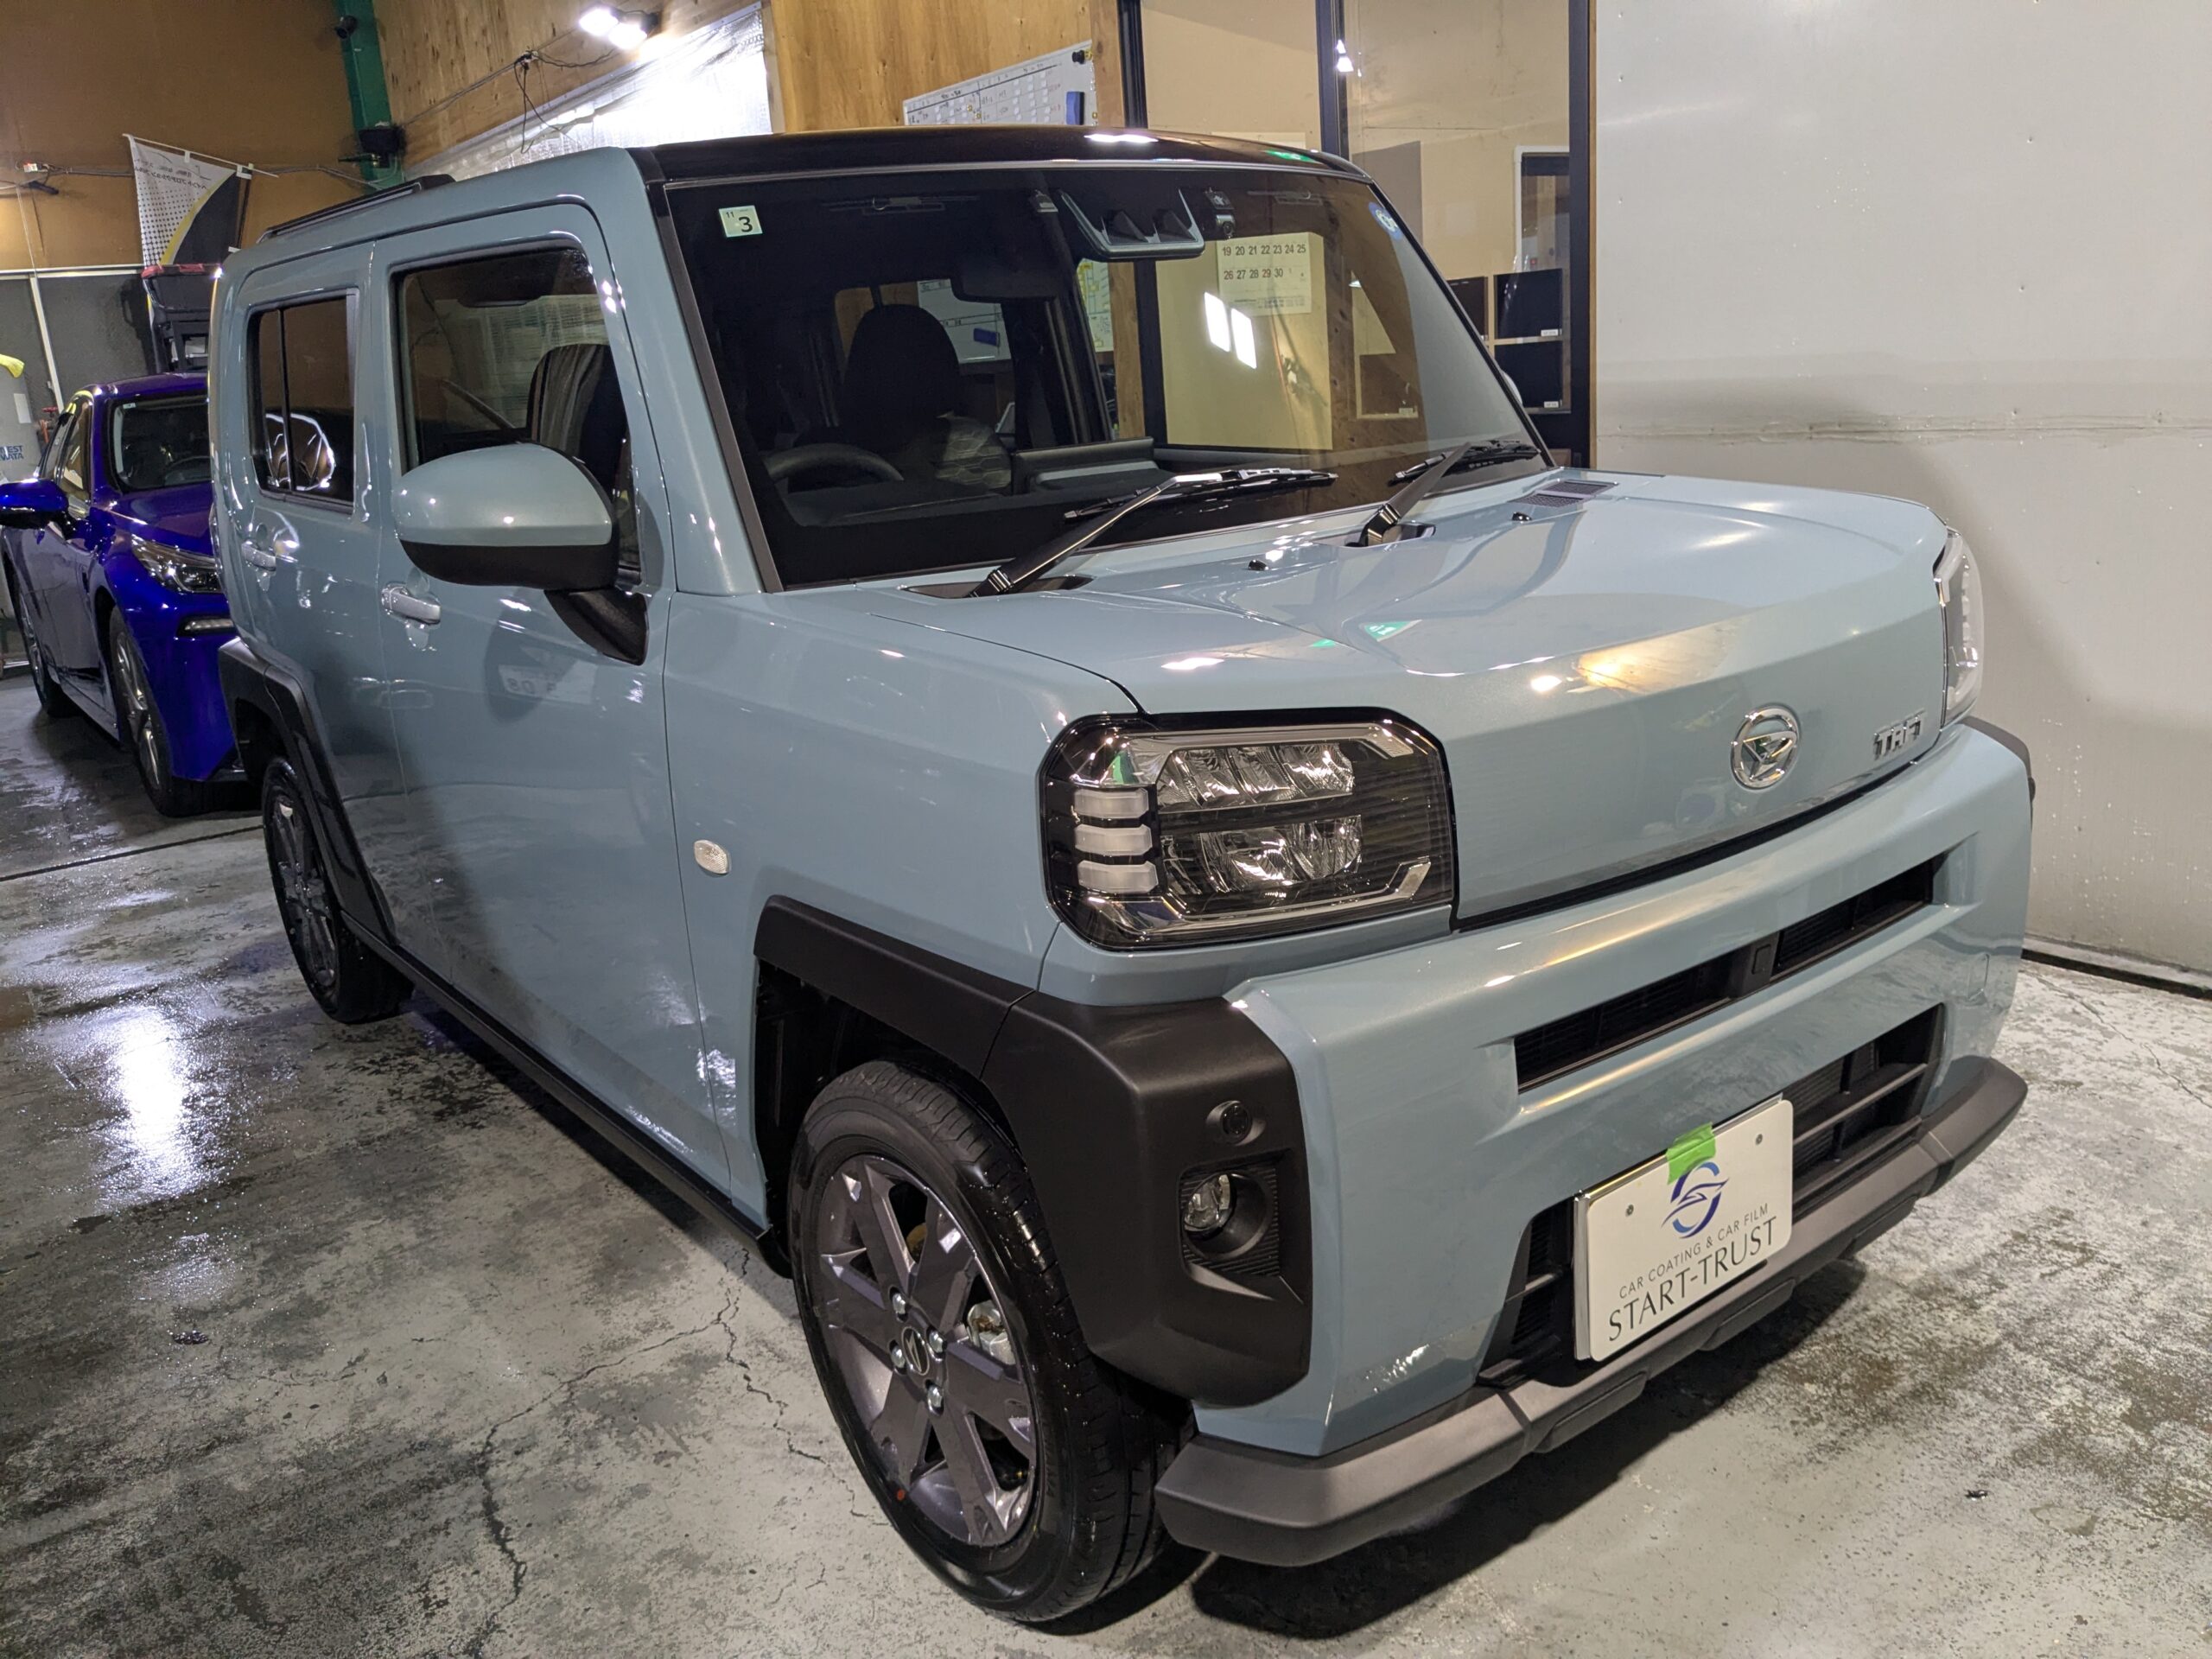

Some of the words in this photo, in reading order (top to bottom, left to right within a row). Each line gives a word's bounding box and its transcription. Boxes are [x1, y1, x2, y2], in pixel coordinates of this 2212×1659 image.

[738, 216, 753, 232] 3
[1222, 246, 1231, 256] 19
[1236, 246, 1245, 256] 20
[1249, 245, 1257, 255] 21
[1261, 245, 1270, 254] 22
[1273, 245, 1282, 254] 23
[1285, 244, 1294, 253] 24
[1297, 244, 1306, 253] 25
[1224, 270, 1234, 280] 26
[1236, 270, 1246, 280] 27
[1249, 269, 1259, 279] 28
[1262, 269, 1271, 278] 29
[1274, 268, 1283, 277] 30
[1619, 1276, 1643, 1299] CAR
[1648, 1243, 1701, 1283] COATING
[1706, 1236, 1713, 1248] &
[1717, 1220, 1739, 1242] CAR
[1744, 1203, 1769, 1226] FILM
[1608, 1216, 1777, 1342] START-TRUST
